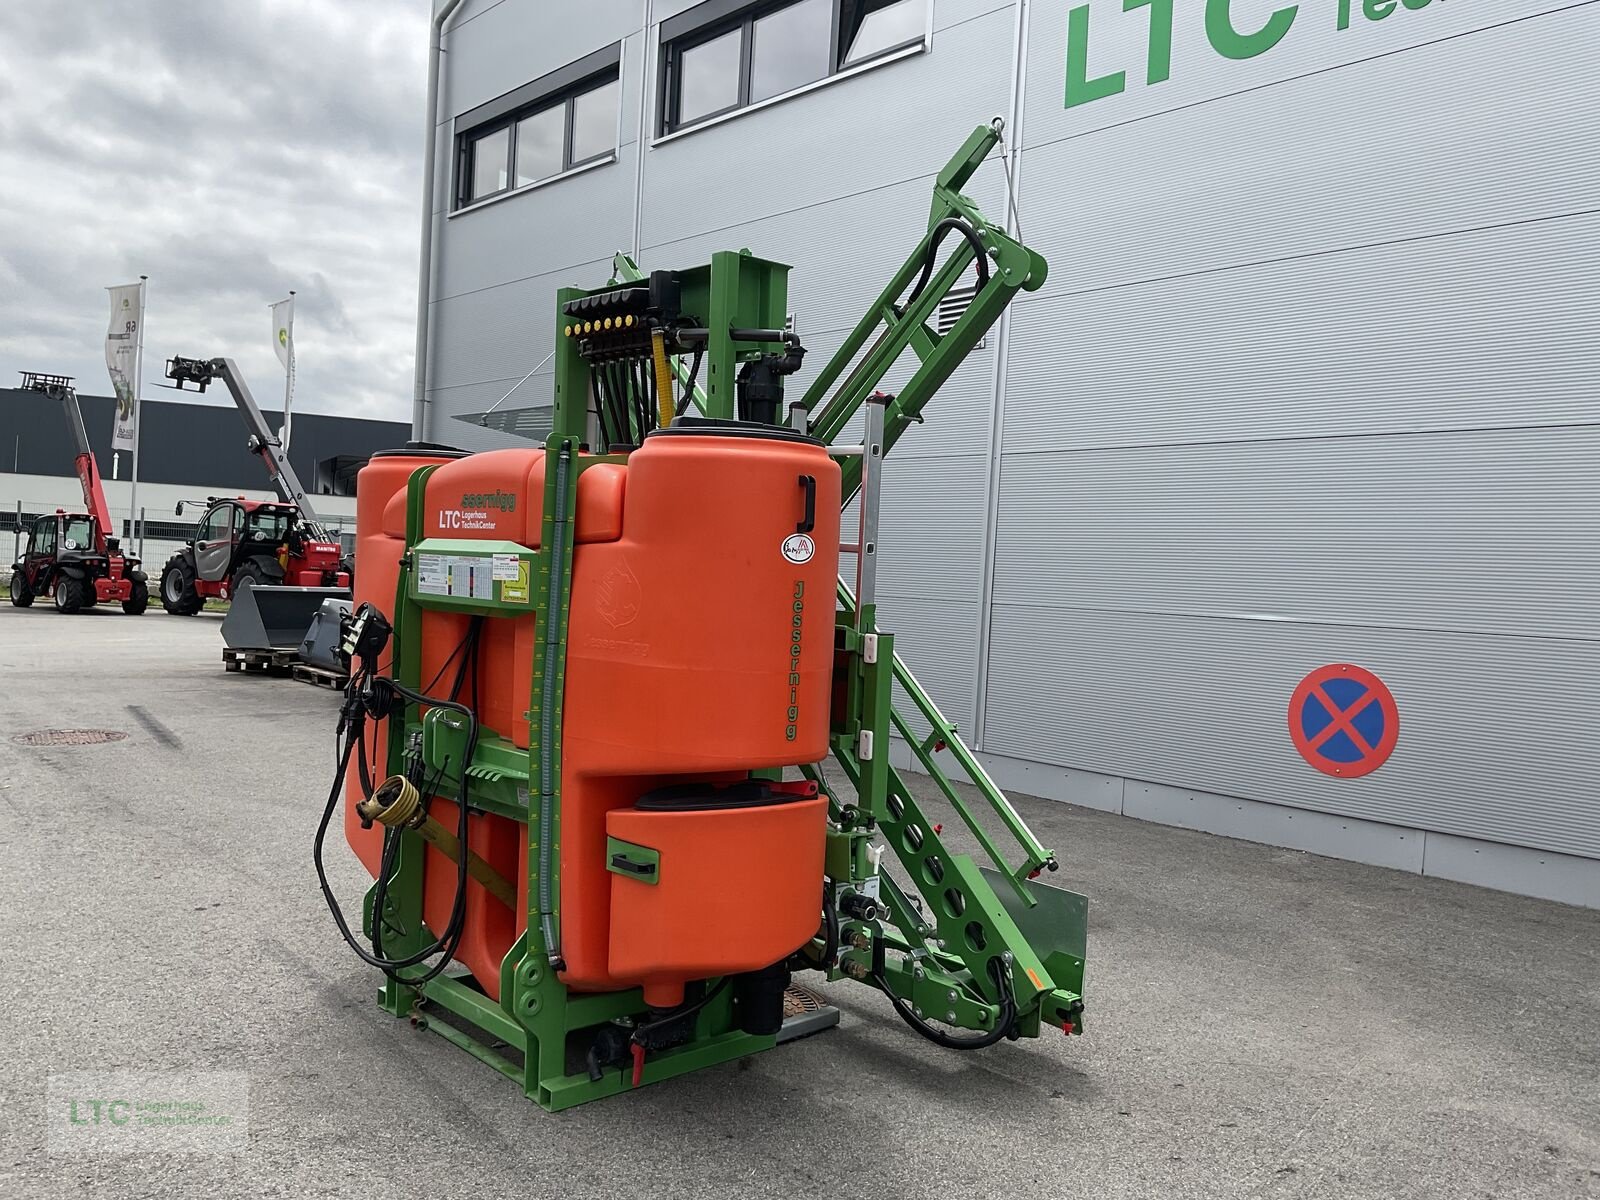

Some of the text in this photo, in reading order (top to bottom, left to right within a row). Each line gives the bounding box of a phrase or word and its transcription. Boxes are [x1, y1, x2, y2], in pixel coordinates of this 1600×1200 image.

[1065, 0, 1298, 109] LTC
[439, 510, 461, 529] LTC
[461, 510, 487, 520] Lagerhaus
[461, 521, 496, 530] TechnikCenter
[786, 580, 804, 741] Jessernigg
